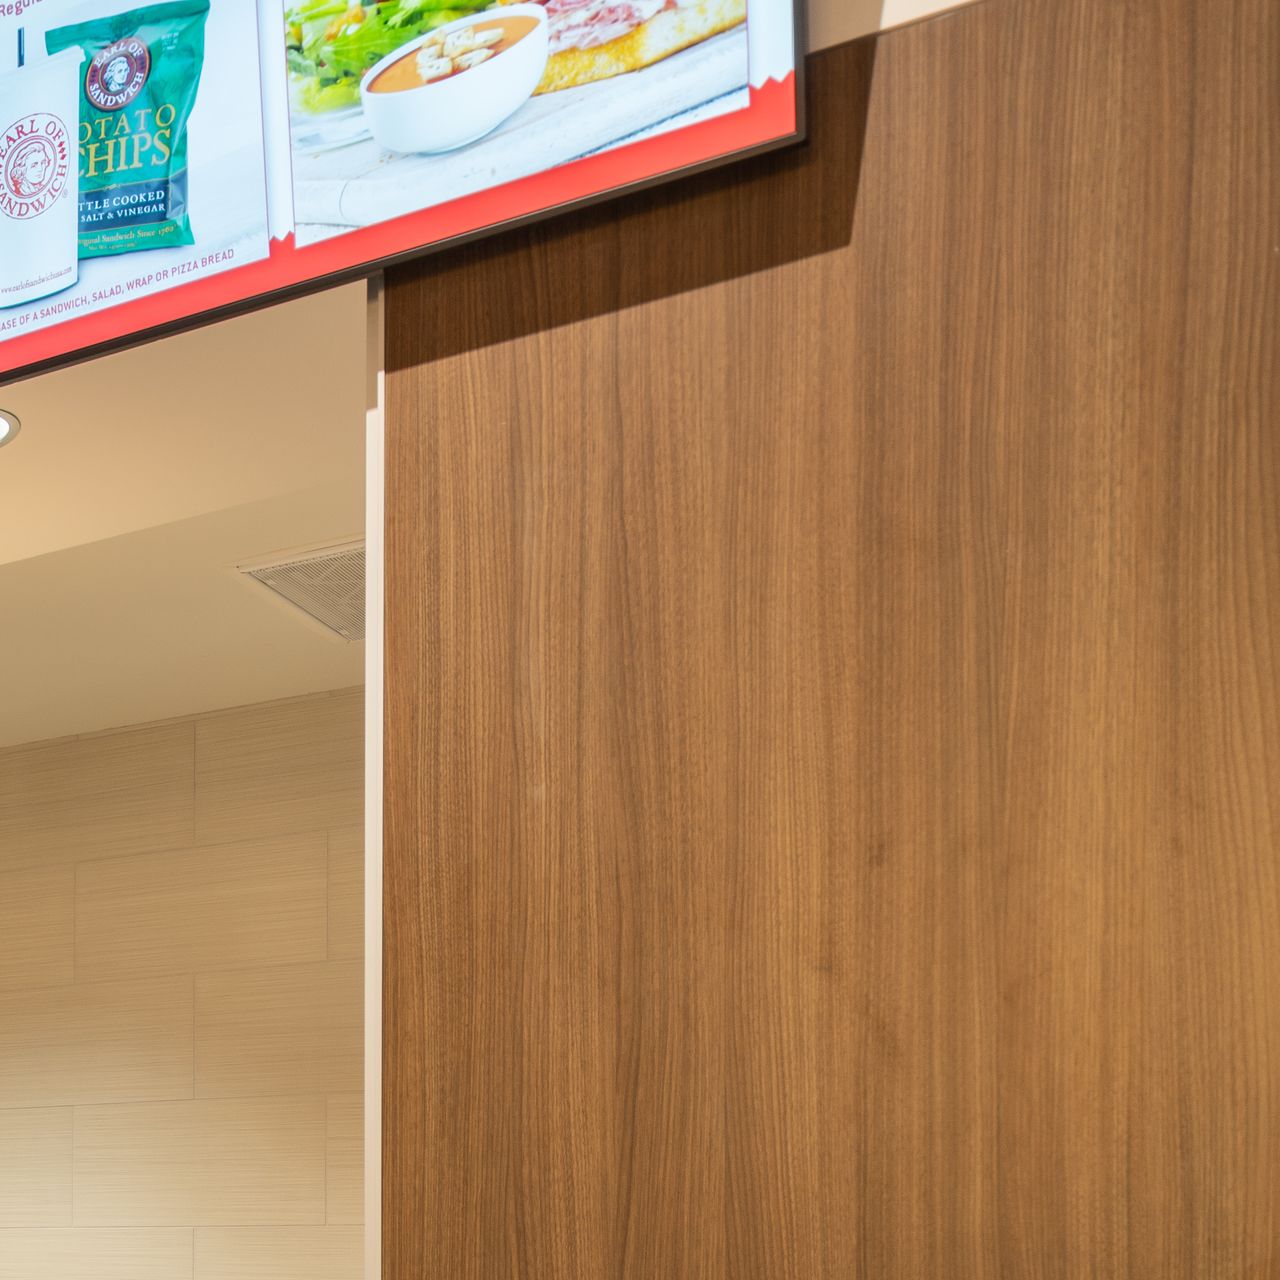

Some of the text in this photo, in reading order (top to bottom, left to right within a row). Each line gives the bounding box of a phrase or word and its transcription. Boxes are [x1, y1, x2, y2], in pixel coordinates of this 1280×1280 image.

[93, 42, 123, 67] EARL
[127, 40, 145, 57] OF
[88, 72, 145, 107] SANDWICH
[44, 120, 65, 142] OF
[79, 103, 176, 144] OTATO
[78, 190, 165, 212] TTLE COOKED
[80, 203, 166, 223] SALT & VINEGAR
[19, 312, 31, 326] OF
[32, 310, 38, 322] A
[40, 294, 90, 319] SANDWICH,
[91, 283, 124, 303] SALAD,
[126, 274, 153, 292] WRAP
[155, 268, 169, 283] OR
[171, 259, 198, 278] PIZZA
[201, 248, 234, 269] BREAD
